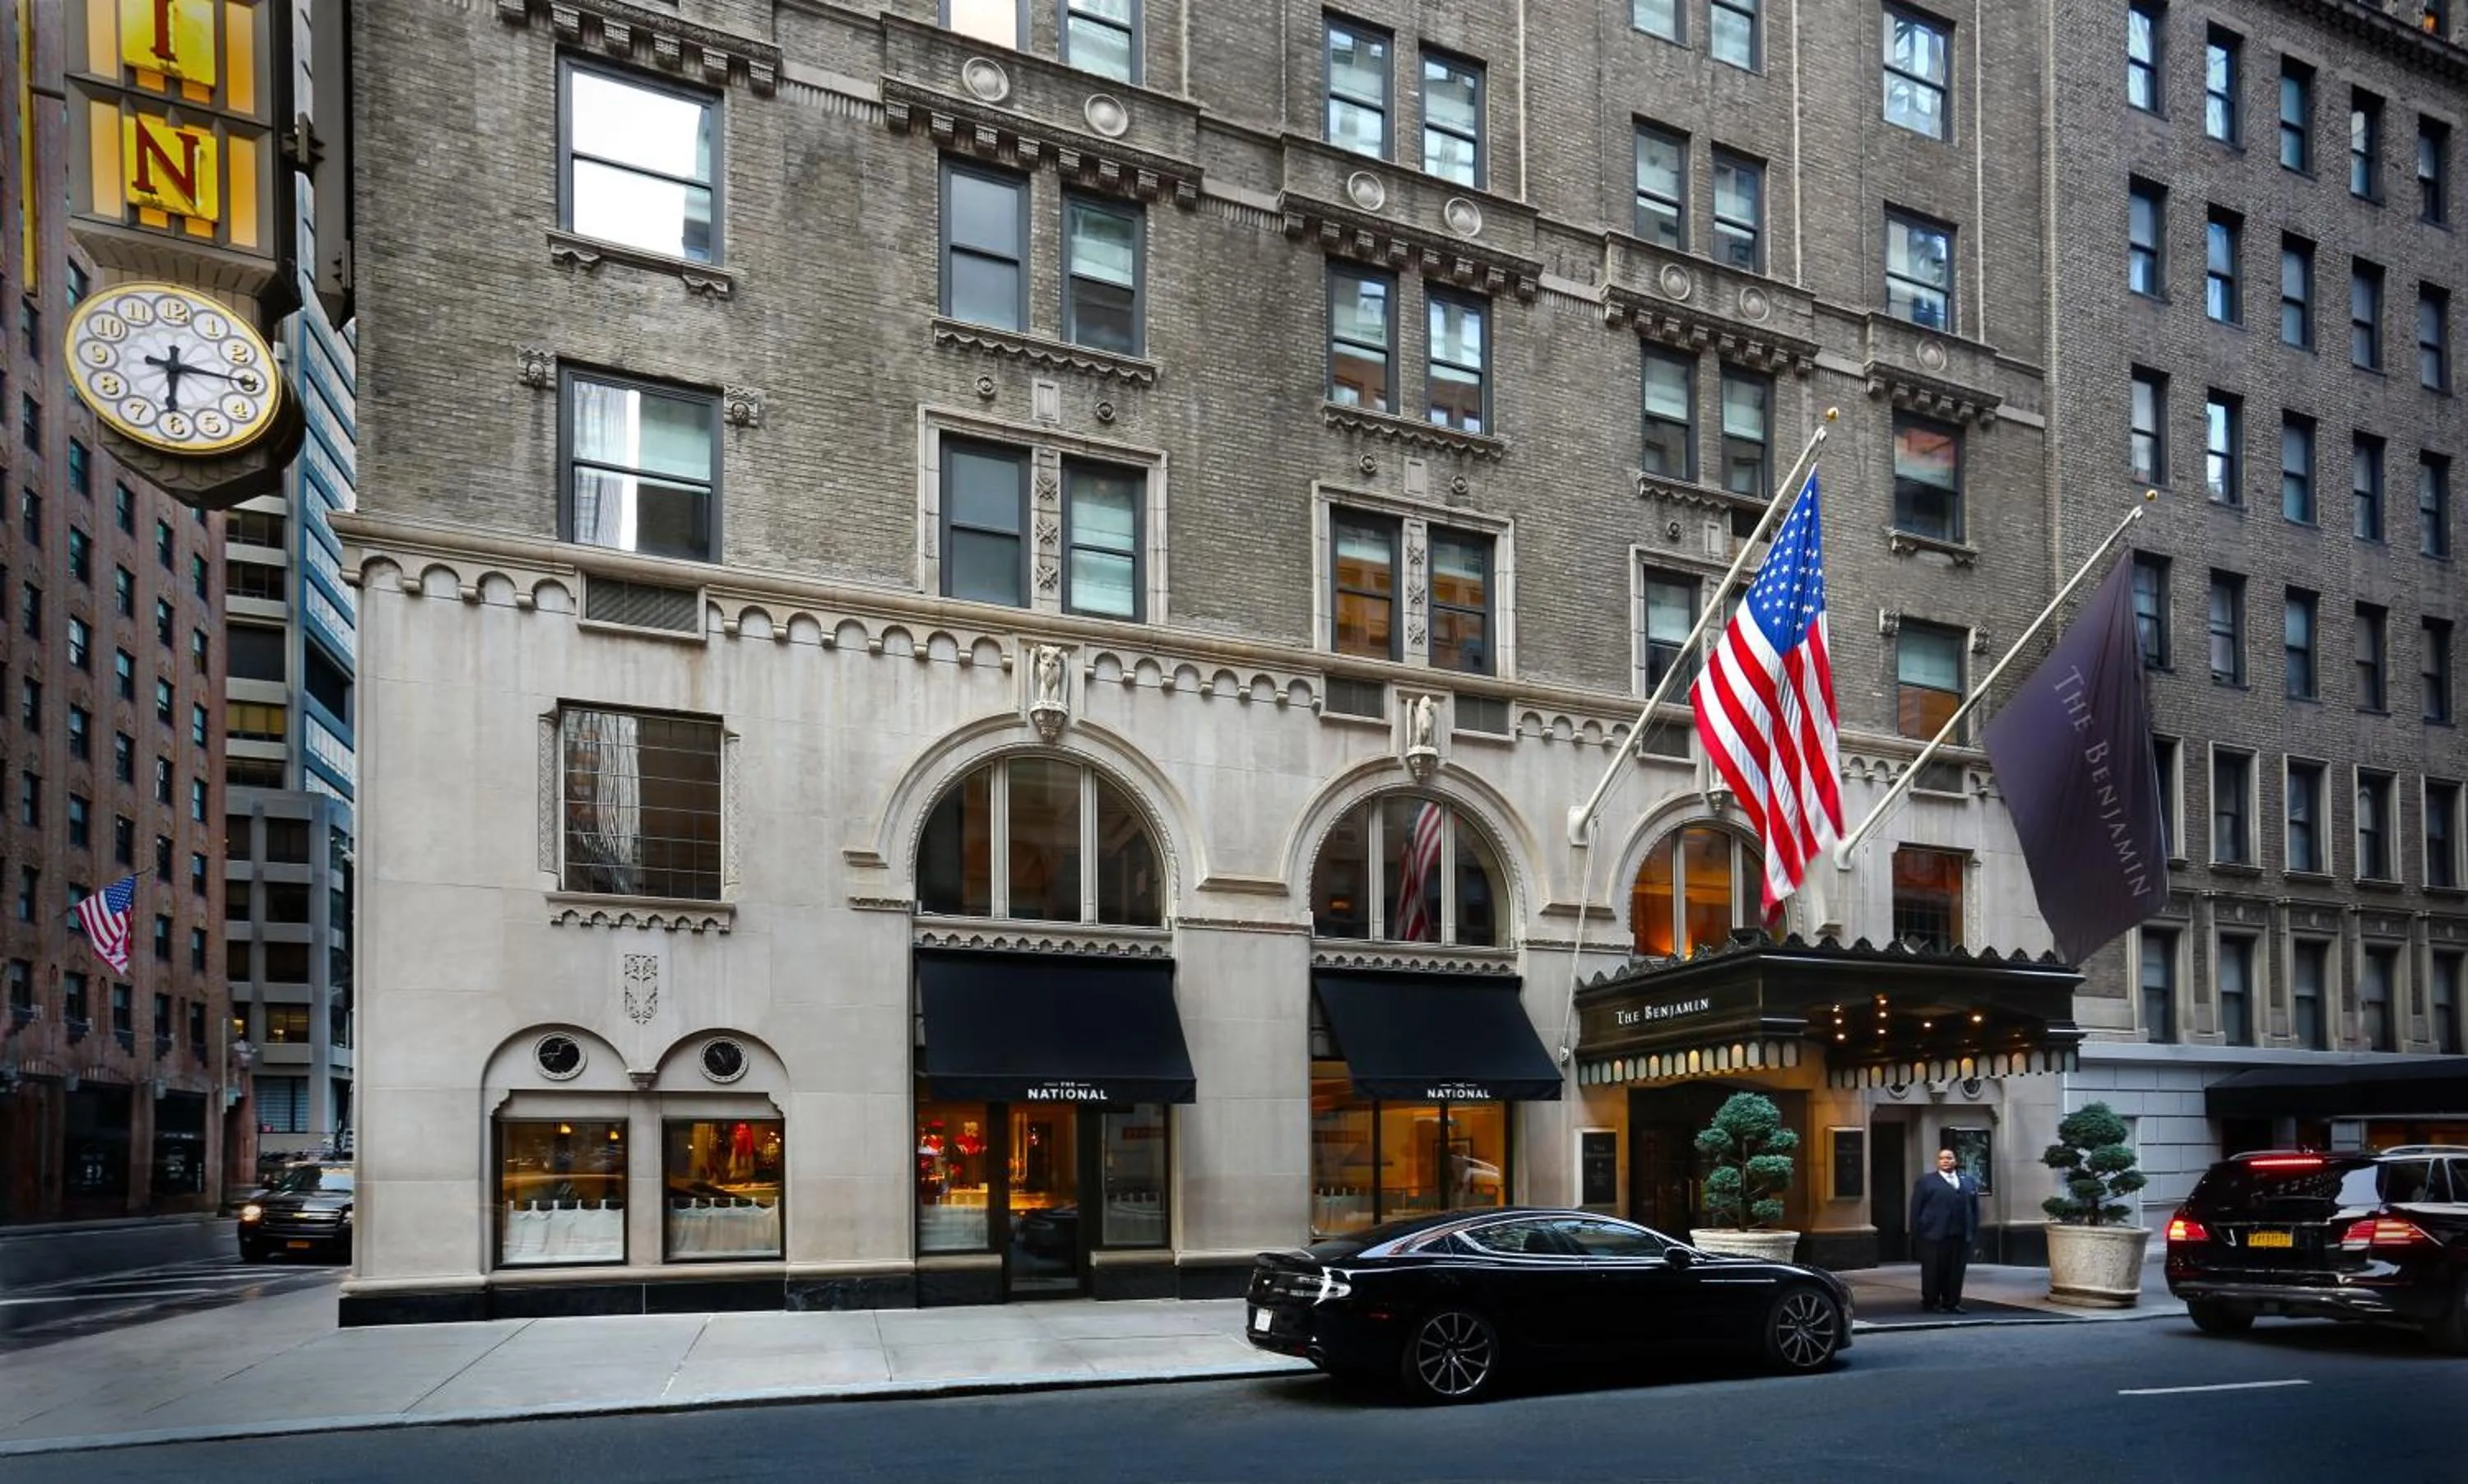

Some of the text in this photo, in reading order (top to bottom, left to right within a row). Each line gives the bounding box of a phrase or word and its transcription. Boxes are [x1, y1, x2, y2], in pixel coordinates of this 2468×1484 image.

[126, 302, 148, 323] 11
[164, 301, 188, 323] 12
[97, 318, 123, 338] 10
[91, 345, 108, 364] 9
[231, 345, 248, 364] 2
[101, 376, 119, 396] 8
[129, 401, 146, 420] 7
[233, 401, 248, 419] 4
[169, 416, 186, 436] 6
[205, 416, 221, 434] 5
[2053, 665, 2152, 897] THE BENJAMIN
[1616, 998, 1709, 1024] THE BENJAMIN
[1028, 1088, 1108, 1100] NATIONAL
[1427, 1088, 1491, 1098] NATIONAL
